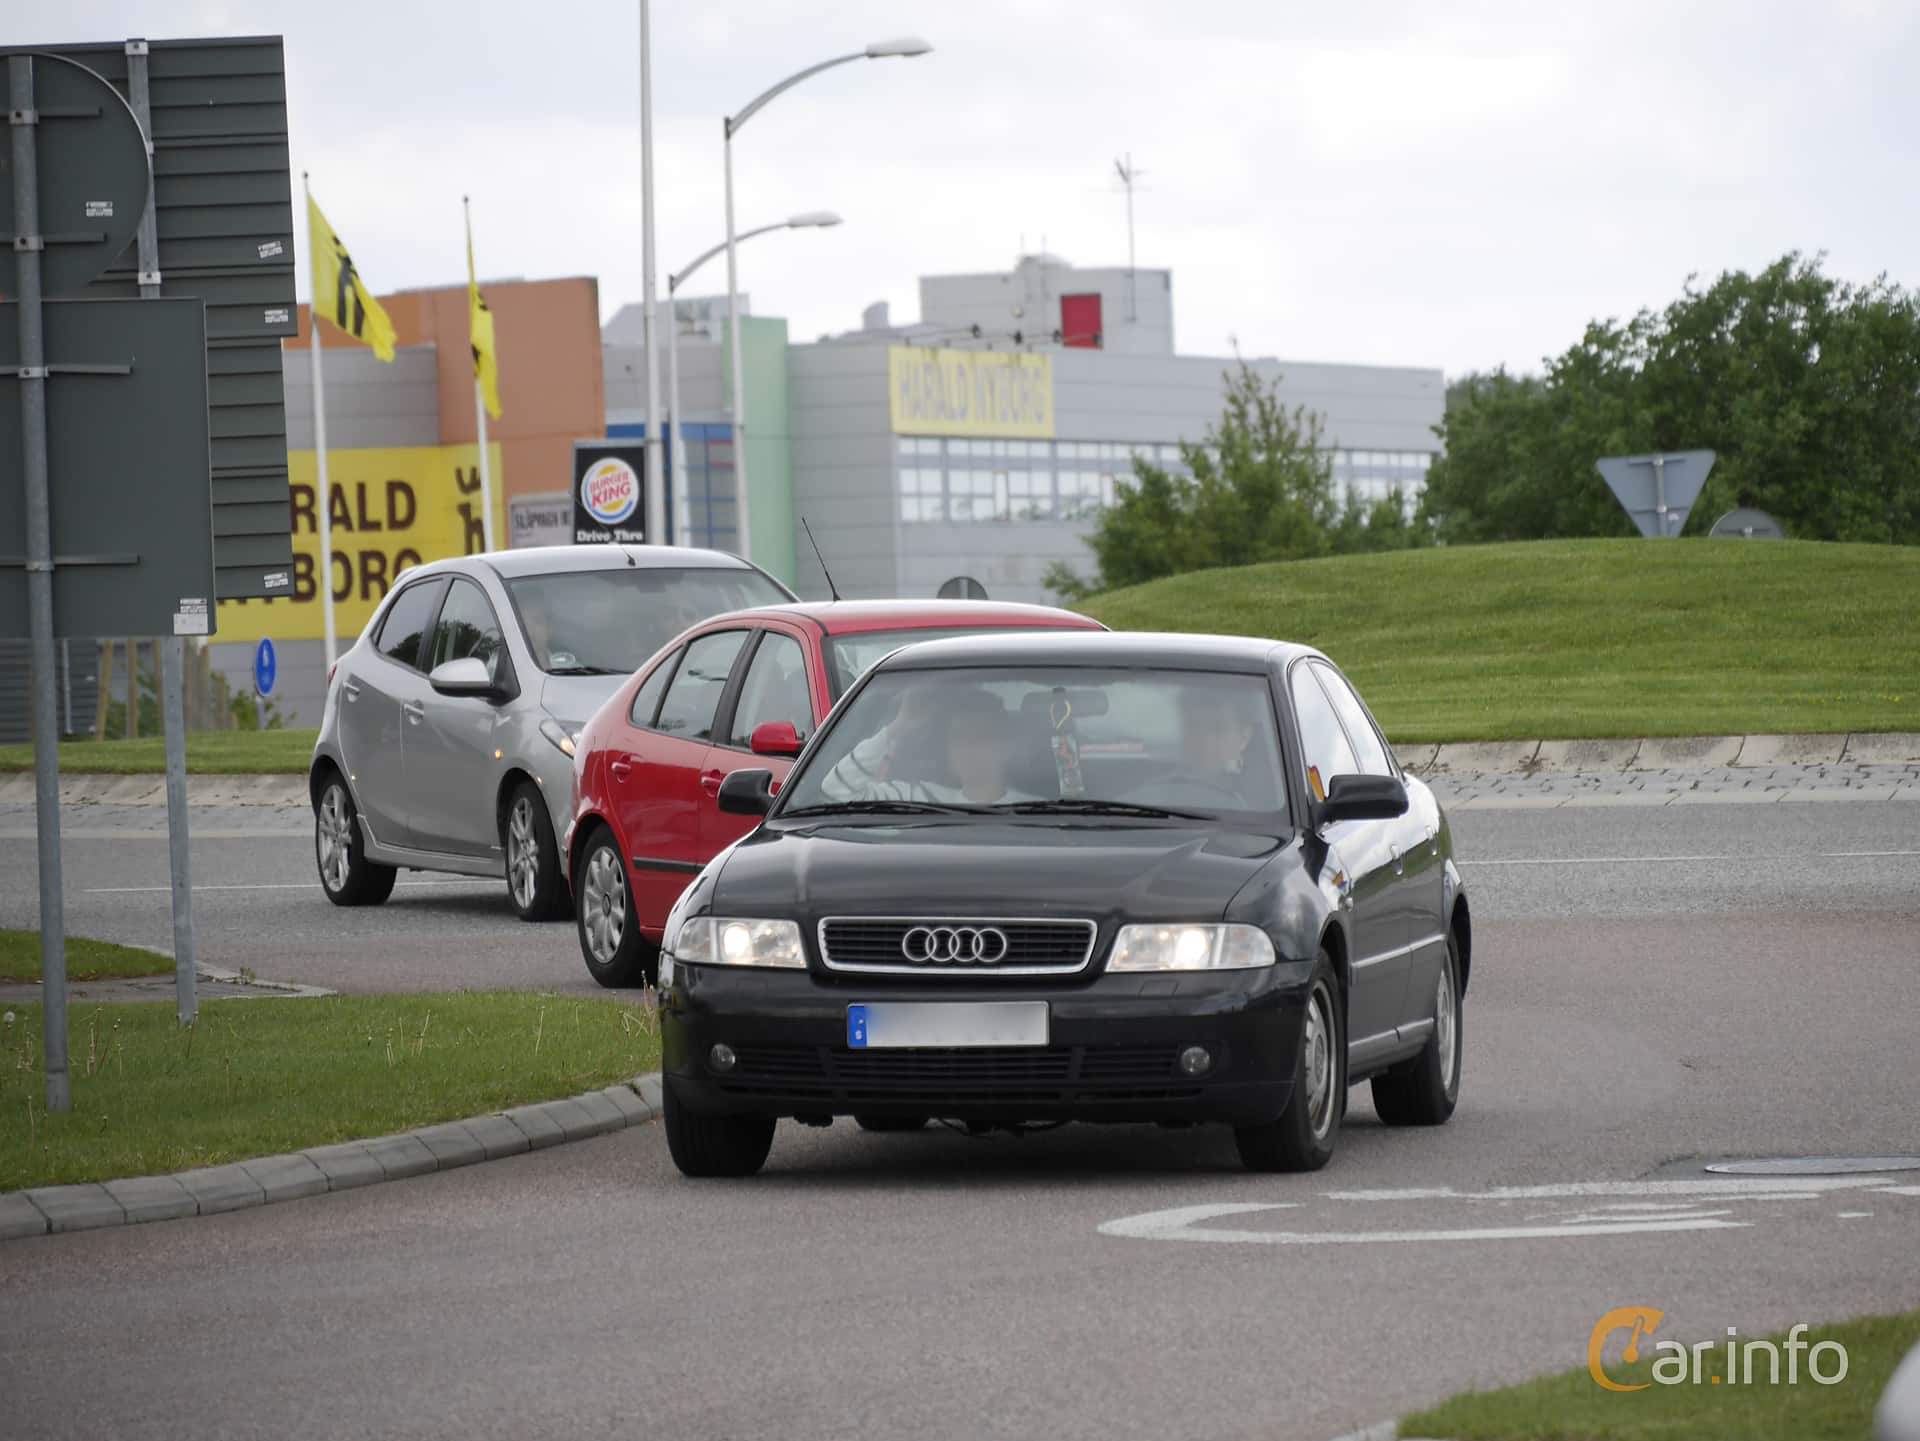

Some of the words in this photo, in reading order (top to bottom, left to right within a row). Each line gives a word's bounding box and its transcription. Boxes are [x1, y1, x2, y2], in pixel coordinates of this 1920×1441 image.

[590, 471, 630, 493] BURGER
[289, 480, 416, 535] RALD
[592, 481, 632, 509] KING
[576, 530, 611, 542] Drive
[614, 530, 644, 542] Thru
